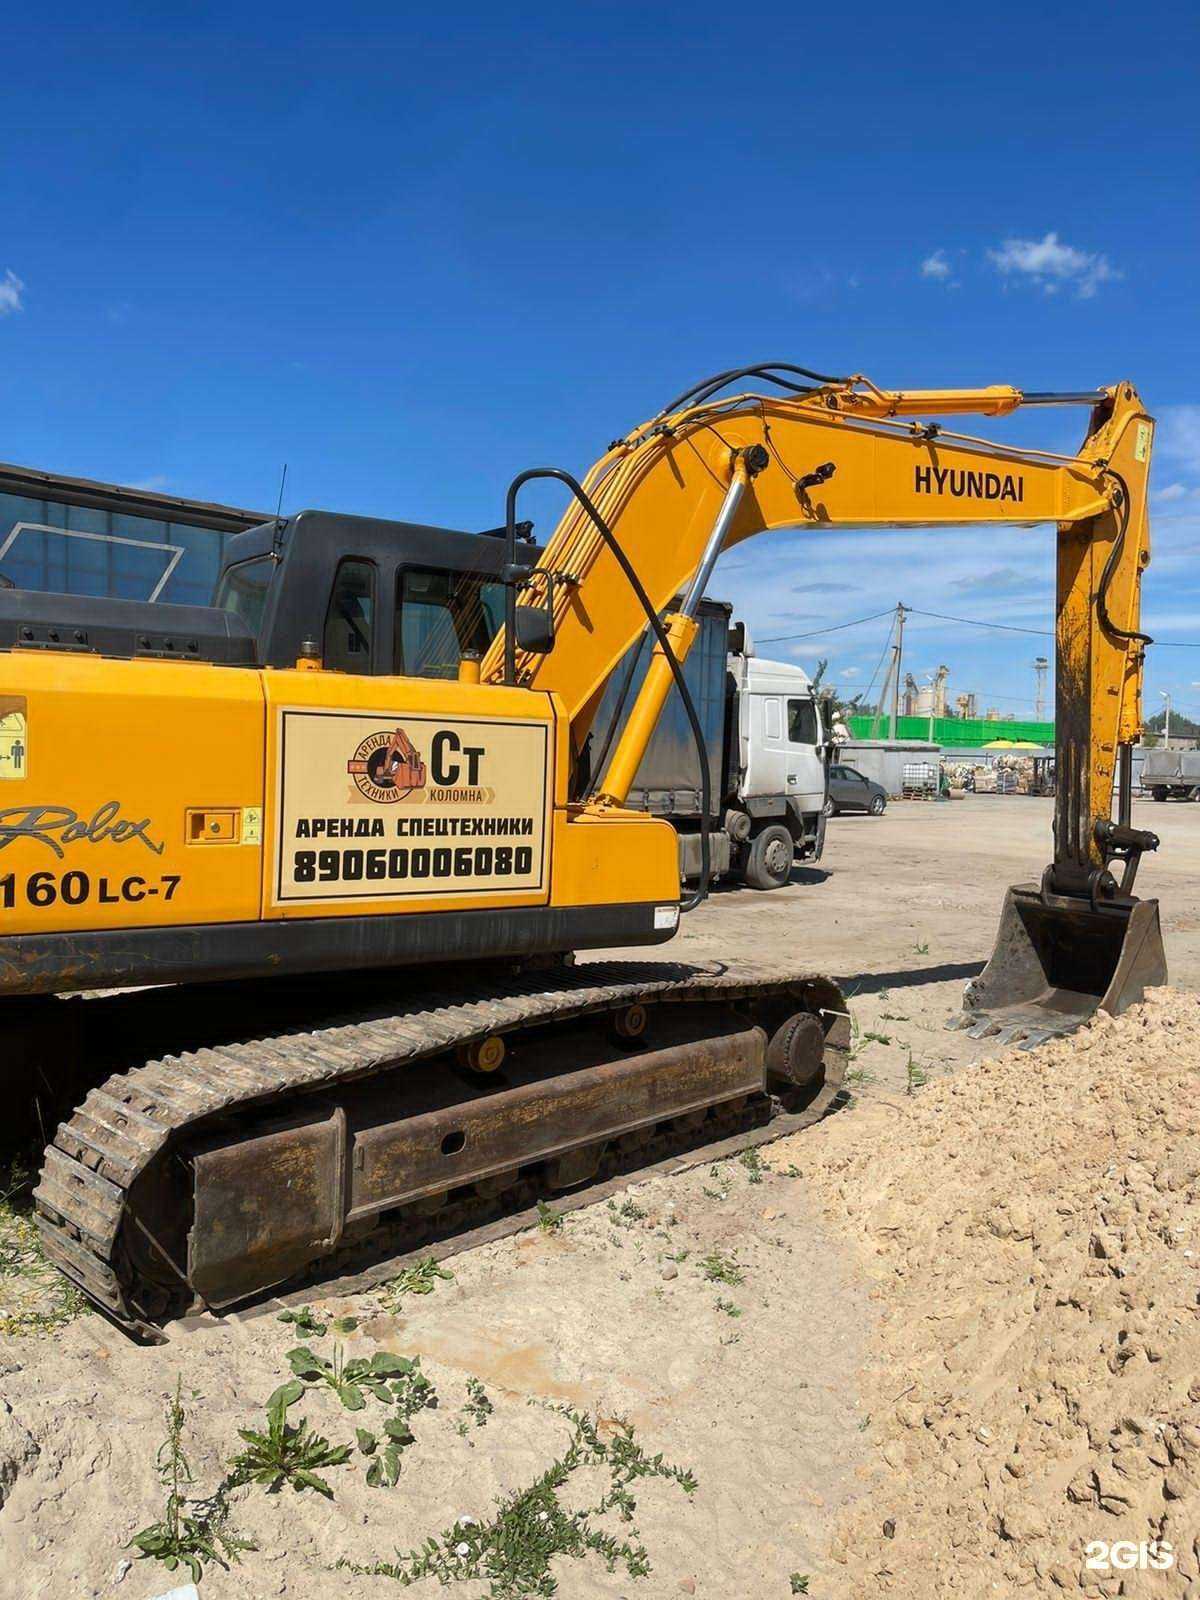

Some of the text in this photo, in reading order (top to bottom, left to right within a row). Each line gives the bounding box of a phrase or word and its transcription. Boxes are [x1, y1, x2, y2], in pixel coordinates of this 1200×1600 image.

[915, 465, 1024, 502] HYUNDAI
[358, 734, 392, 760] АРЕНДА
[358, 775, 400, 801] ТЕХНИКИ
[430, 788, 482, 802] КОЛОМНА
[295, 818, 533, 838] АРЕНДА СПЕЦТЕХНИКИ
[293, 846, 532, 882] 89060006080
